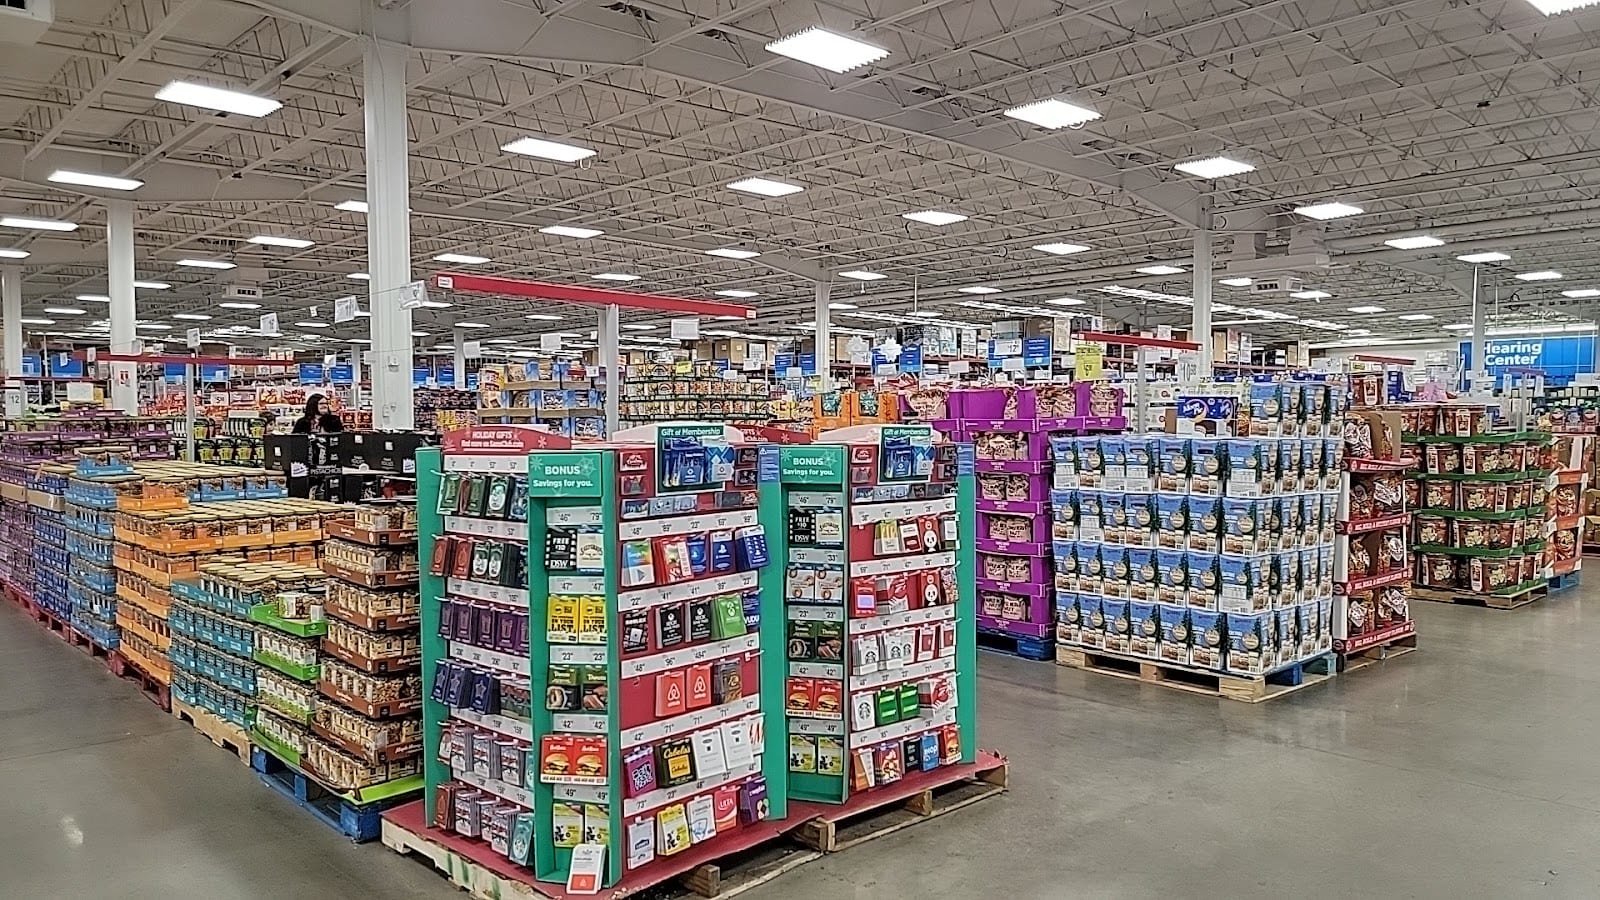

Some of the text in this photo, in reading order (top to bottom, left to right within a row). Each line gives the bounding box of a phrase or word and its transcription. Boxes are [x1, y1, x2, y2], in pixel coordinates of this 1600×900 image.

[1484, 341, 1542, 355] Hearing
[1485, 354, 1538, 365] Center
[661, 428, 674, 436] Gift
[682, 428, 721, 436] Membership
[792, 457, 824, 466] BONUS
[544, 466, 581, 475] BONUS
[782, 468, 808, 476] Savings
[533, 479, 594, 489] Savings for you.
[552, 537, 570, 545] FREE
[794, 534, 810, 543] DSW
[550, 559, 568, 568] DSW
